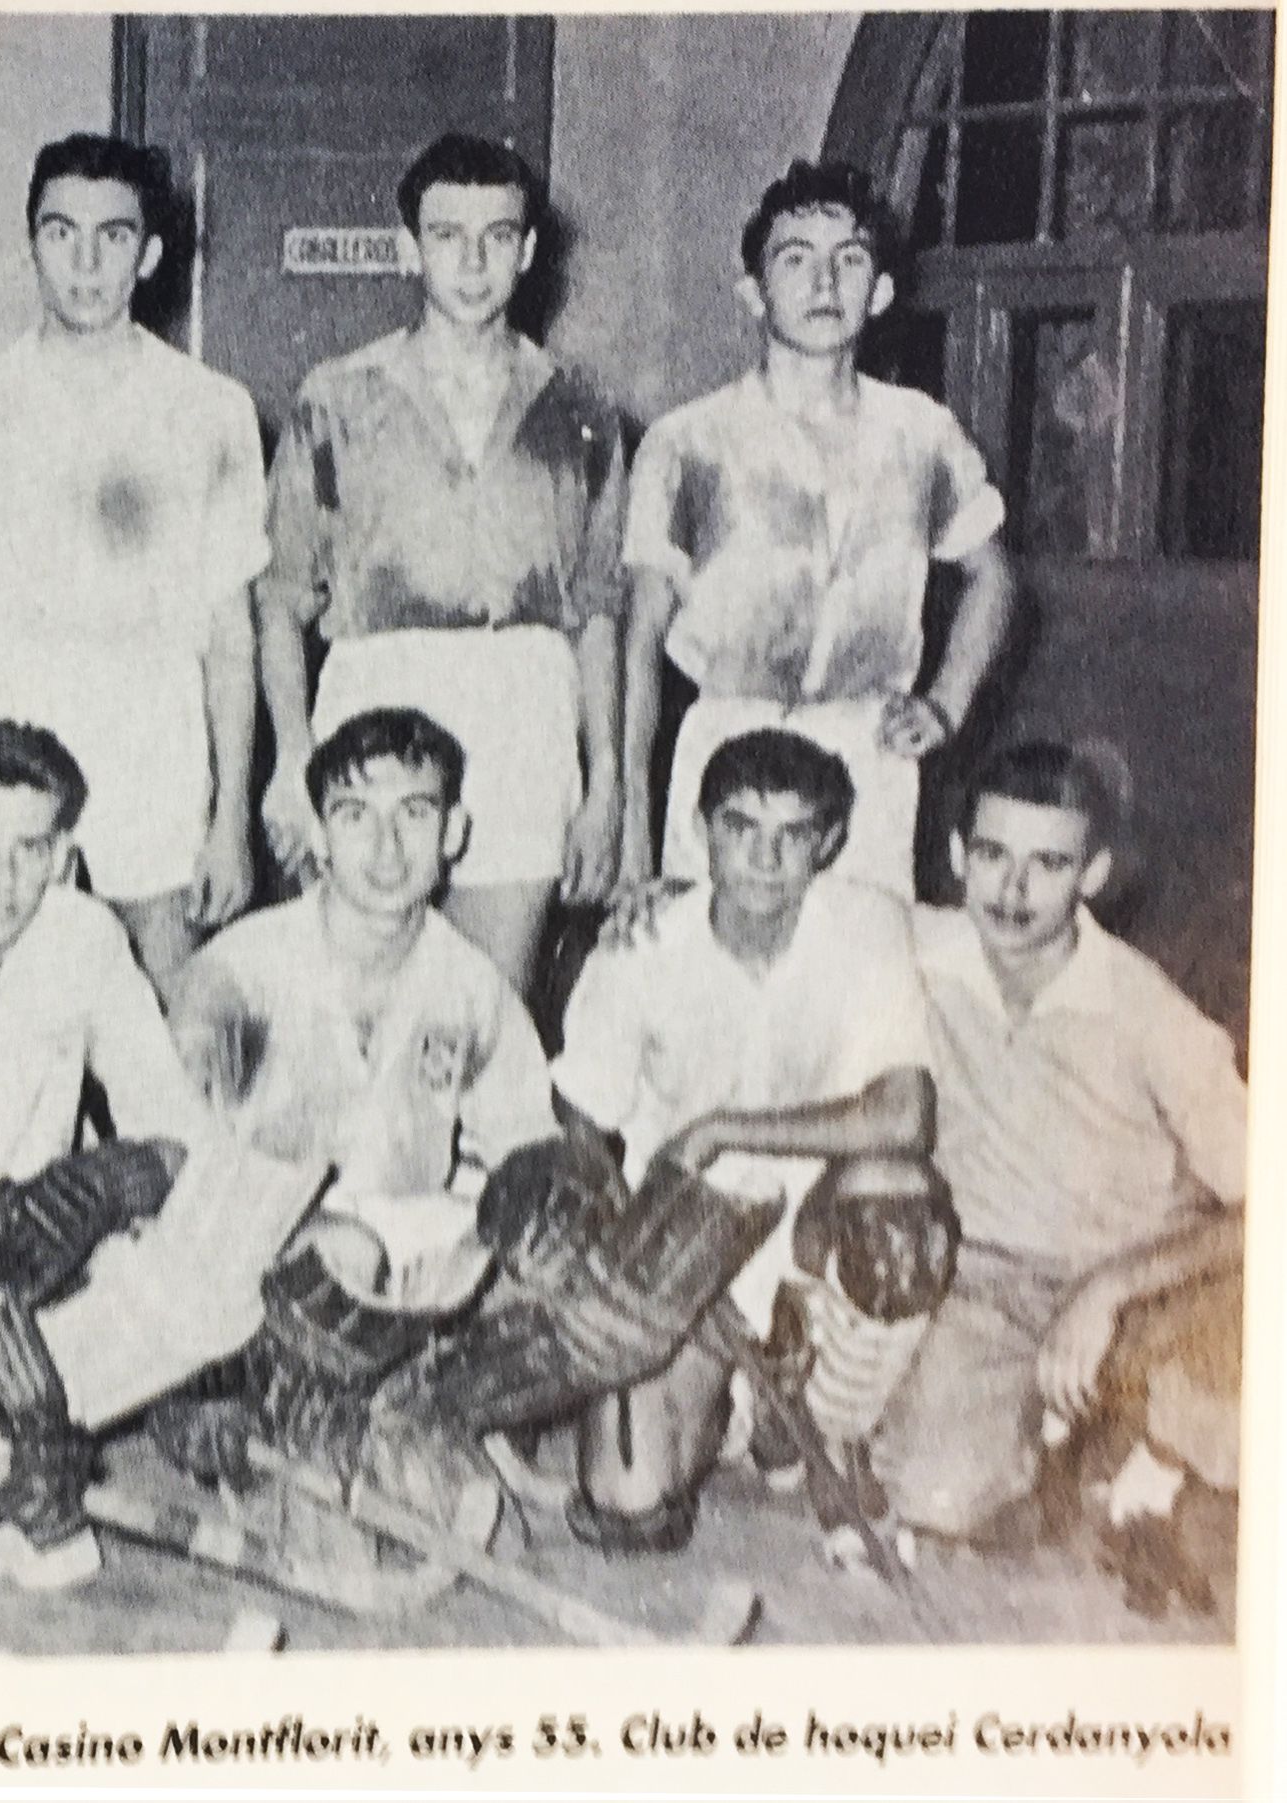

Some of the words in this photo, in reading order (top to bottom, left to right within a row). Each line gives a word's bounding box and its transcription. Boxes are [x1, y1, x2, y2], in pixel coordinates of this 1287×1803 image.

[408, 1725, 515, 1770] anys
[532, 1714, 602, 1758] 55.
[620, 1709, 717, 1757] Club
[733, 1709, 788, 1756] de
[803, 1709, 958, 1766] hoquei
[973, 1709, 1232, 1766] Cerdanyola
